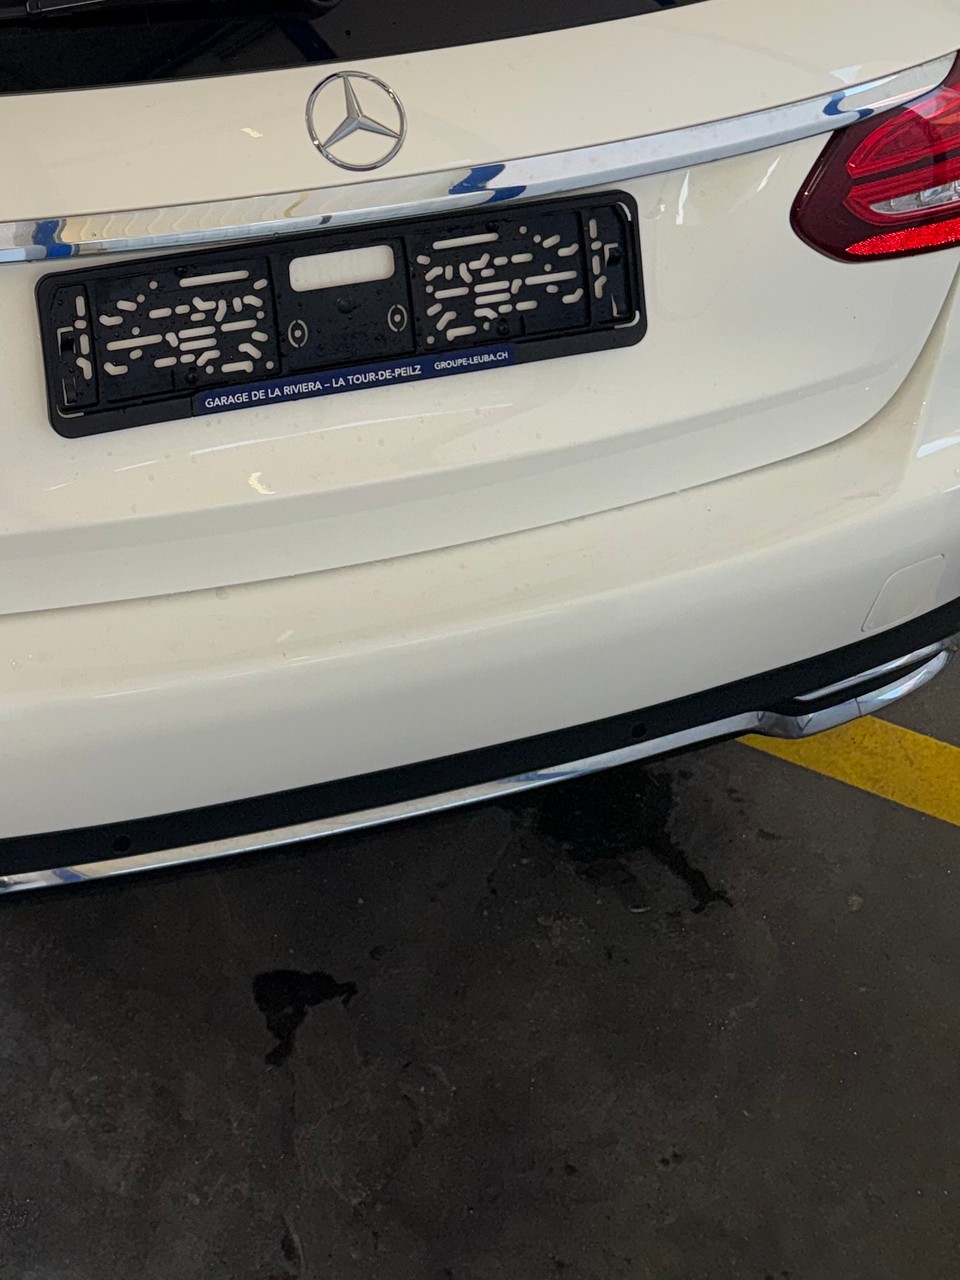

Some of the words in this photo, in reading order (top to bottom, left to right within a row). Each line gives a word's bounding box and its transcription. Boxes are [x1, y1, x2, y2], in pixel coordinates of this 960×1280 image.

[433, 350, 509, 370] GROUPE-LEUBA.CH
[204, 392, 249, 408] GARAGE
[251, 389, 266, 402] DE
[267, 386, 282, 398] LA
[283, 380, 323, 395] RIVIERA
[331, 376, 346, 388] LA
[347, 364, 422, 386] TOUR-DE-PEILZ
